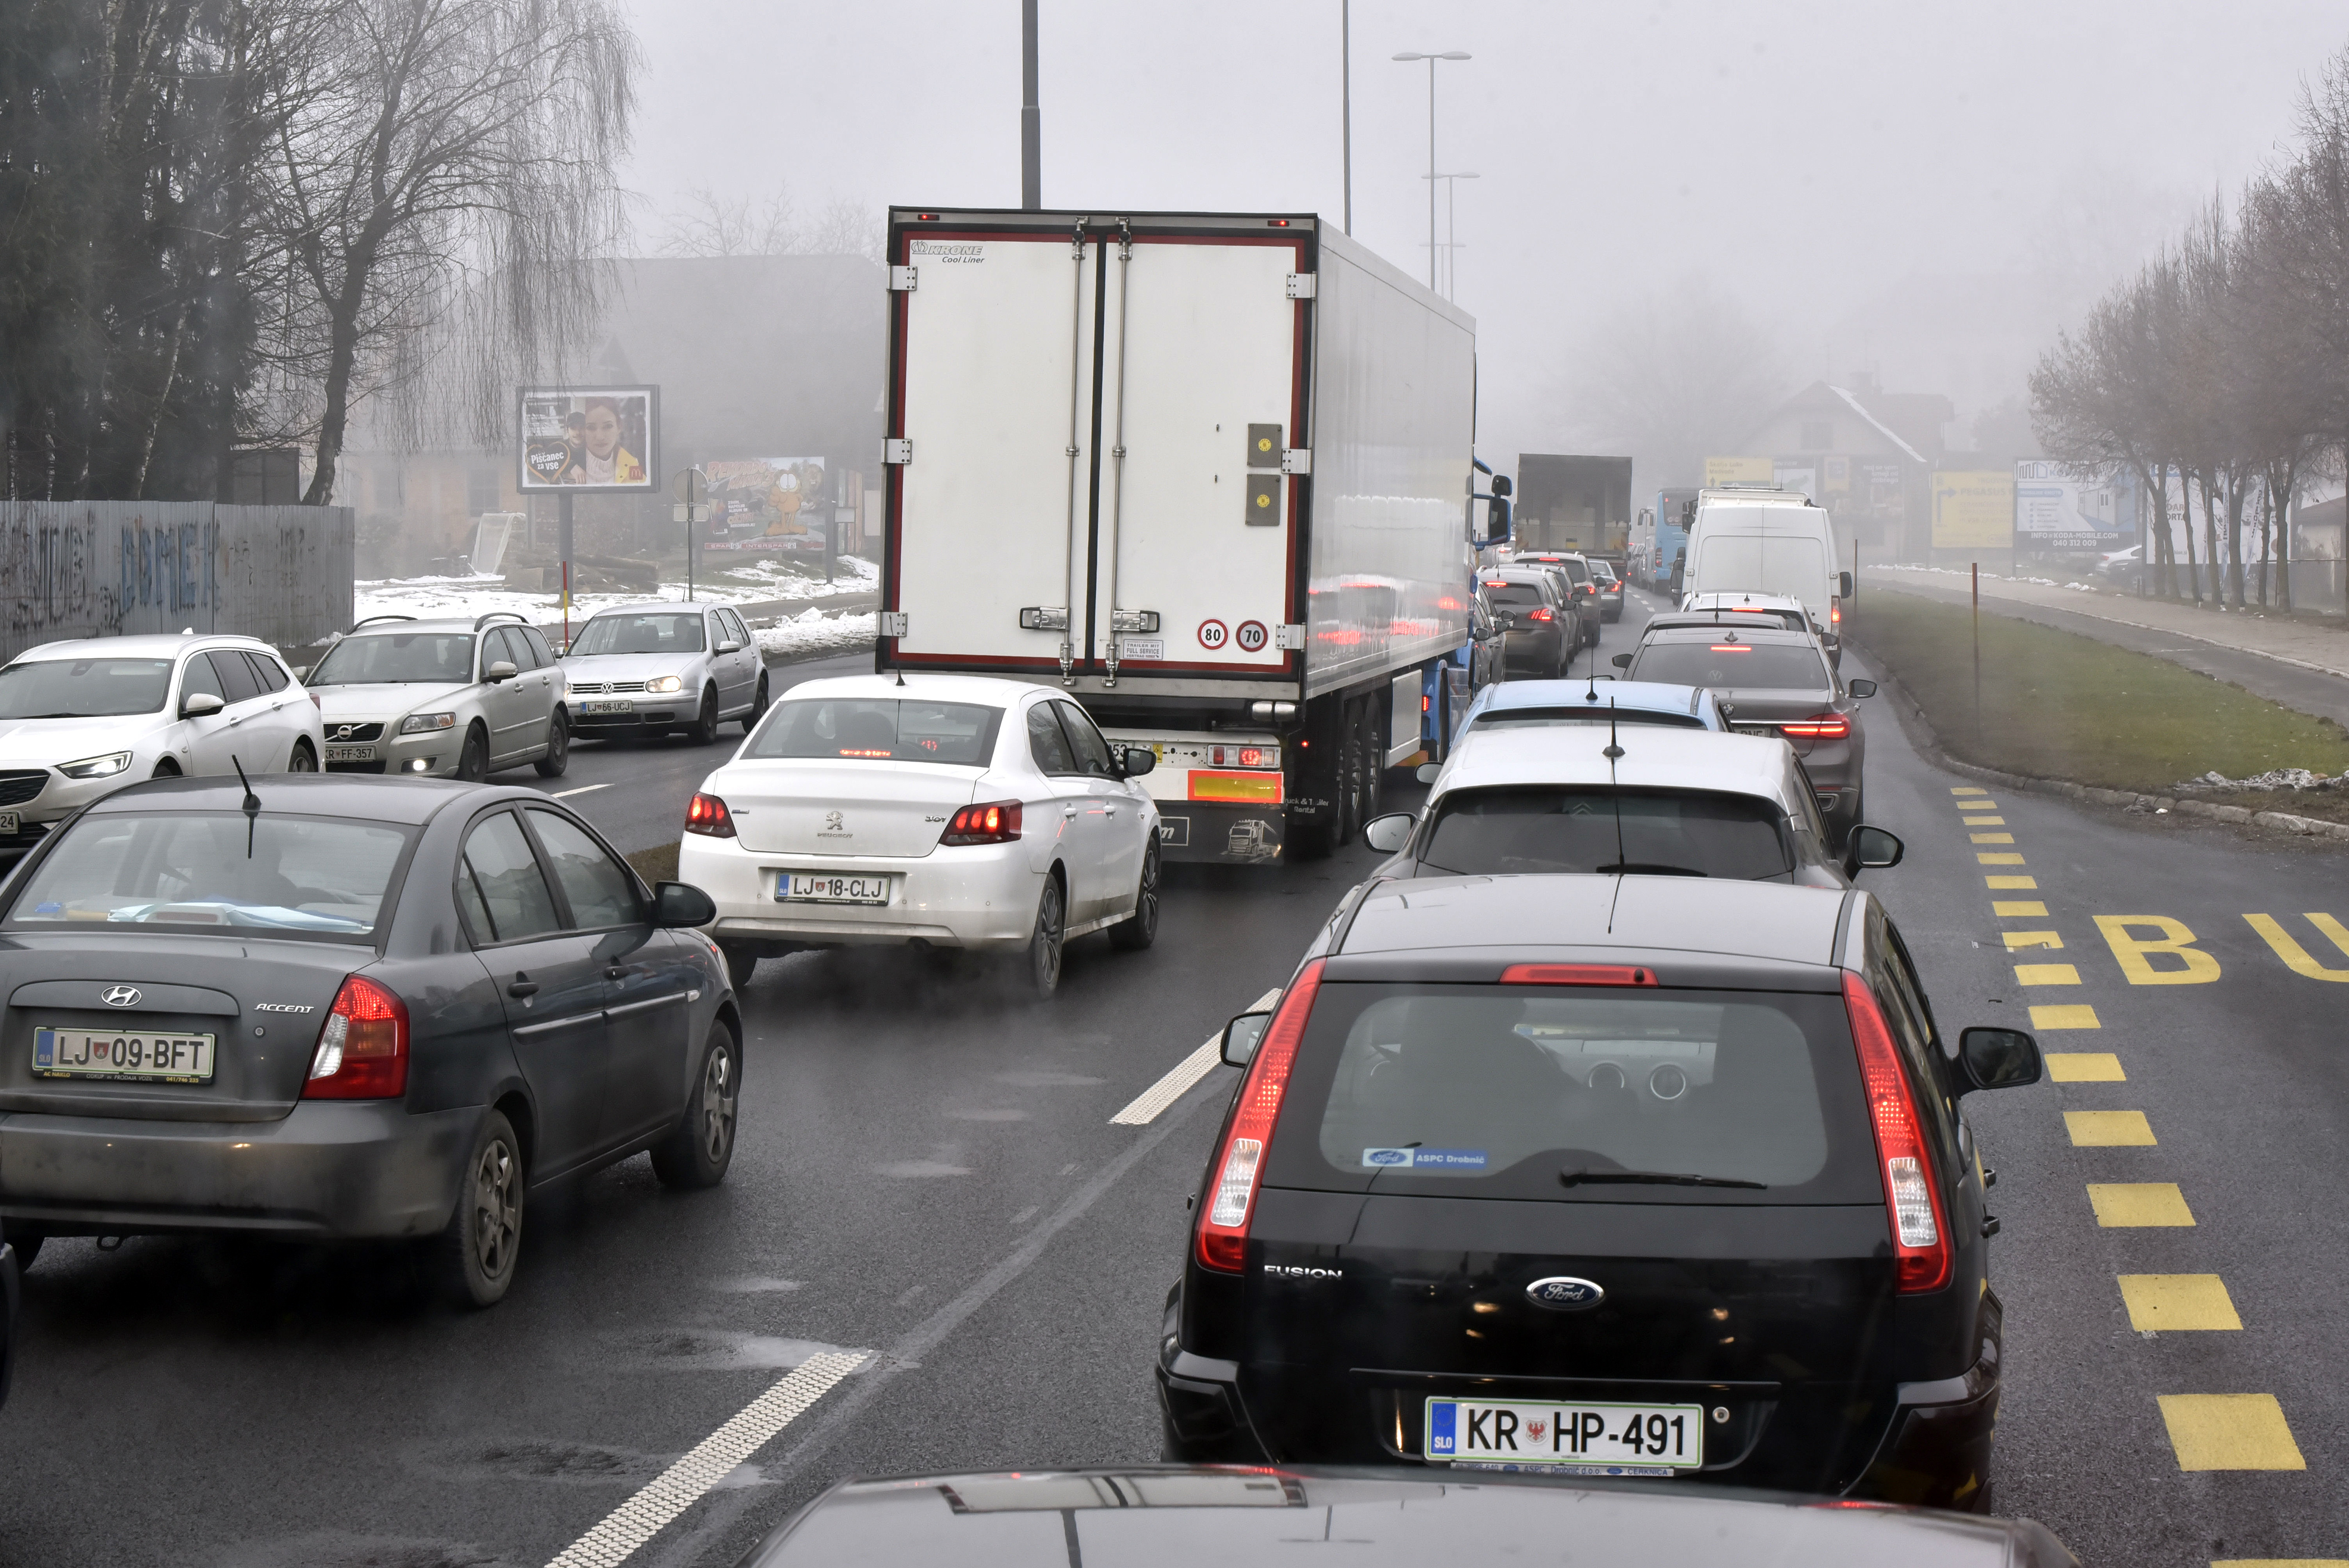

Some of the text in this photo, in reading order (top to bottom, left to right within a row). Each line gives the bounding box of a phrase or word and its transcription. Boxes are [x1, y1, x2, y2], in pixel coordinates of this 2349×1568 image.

[928, 245, 983, 256] KRONE
[531, 451, 565, 465] Piščanec
[545, 461, 559, 471] vse
[706, 461, 768, 482] REKORDO
[762, 471, 776, 487] 3
[1960, 488, 2006, 496] PEGASUS
[1205, 628, 1221, 641] 80
[1245, 630, 1260, 643] 70
[588, 703, 596, 712] LJ
[341, 748, 372, 758] FF-357
[1110, 744, 1128, 757] 53
[794, 877, 882, 898] LJ 18-CLJ
[254, 1003, 314, 1013] ACCENT
[38, 1054, 51, 1064] SLO
[58, 1036, 205, 1070] LJ 09-BFT
[1375, 1152, 1399, 1162] Ford
[1264, 1265, 1342, 1279] FUSION
[1544, 1283, 1585, 1300] Ford
[1468, 1409, 1683, 1456] KR HP-491
[1435, 1436, 1452, 1449] SLO
